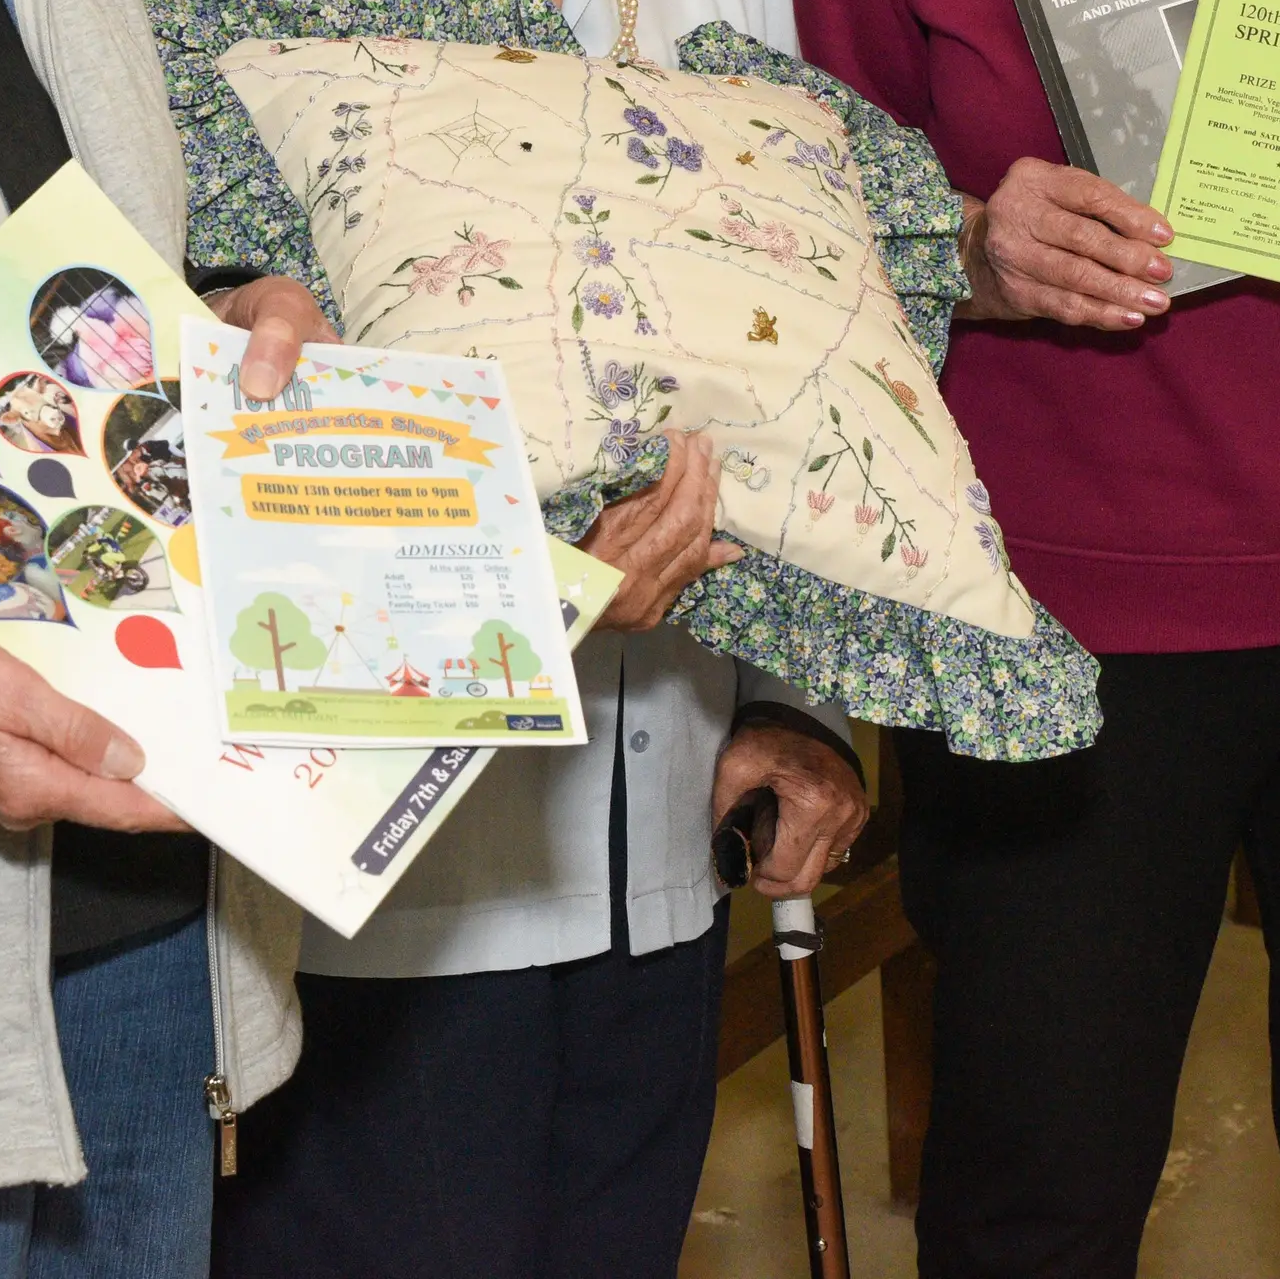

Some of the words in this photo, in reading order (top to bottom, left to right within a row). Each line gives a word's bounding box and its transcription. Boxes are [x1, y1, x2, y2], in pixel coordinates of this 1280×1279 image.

[1082, 5, 1112, 21] AND
[1239, 74, 1277, 91] PRIZE
[1205, 92, 1235, 105] Produce,
[1238, 99, 1269, 112] Women's
[1217, 87, 1263, 103] Horticultural,
[1207, 120, 1241, 133] FRIDAY
[1243, 127, 1257, 136] and
[1199, 182, 1229, 194] ENTRIES
[228, 363, 313, 412] 1th
[239, 413, 384, 444] Wangaratta
[392, 417, 461, 446] Show
[274, 443, 434, 469] PROGRAM
[257, 482, 300, 495] FRIDAY
[304, 484, 330, 497] 13th
[334, 485, 381, 498] October
[385, 487, 412, 498] 9am
[416, 487, 428, 498] to
[431, 487, 459, 501] 9pm
[252, 501, 311, 516] SATURDAY
[315, 504, 341, 517] 14th
[345, 505, 393, 518] October
[396, 506, 423, 518] 9am
[427, 507, 440, 518] to
[442, 507, 471, 519] 4pm
[394, 543, 504, 557] ADMISSION
[219, 743, 265, 771] W
[440, 746, 471, 770] Sat
[294, 747, 337, 788] 20
[431, 767, 451, 783] &
[409, 782, 439, 810] 7th
[372, 809, 420, 857] Friday
